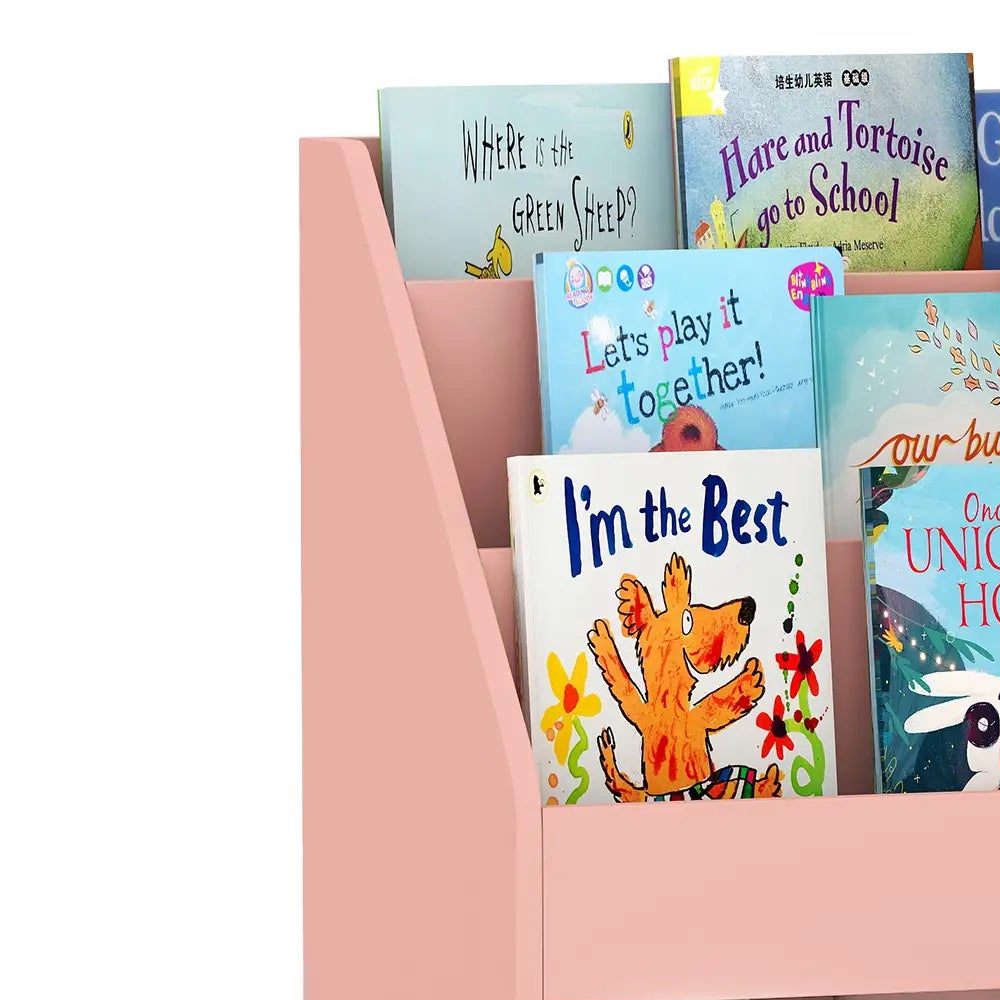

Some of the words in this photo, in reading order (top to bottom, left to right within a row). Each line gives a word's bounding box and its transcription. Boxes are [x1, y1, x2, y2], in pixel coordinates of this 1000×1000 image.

[775, 72, 833, 90] 培生幼儿英语
[462, 116, 527, 183] WHERE
[535, 136, 545, 167] is
[719, 136, 789, 202] Hare
[794, 116, 833, 156] and
[838, 100, 949, 182] Tortoise
[512, 193, 565, 236] GREEN
[572, 175, 637, 252] SHEEP?
[757, 204, 781, 248] go
[784, 188, 806, 221] to
[809, 161, 900, 223] School
[854, 239, 884, 251] Meserve
[581, 325, 649, 374] Let's
[658, 309, 711, 362] play
[720, 288, 742, 330] it
[617, 340, 765, 424] together!
[866, 432, 955, 466] our
[564, 476, 633, 578] I'm
[639, 486, 691, 543] the
[702, 474, 789, 557] Best
